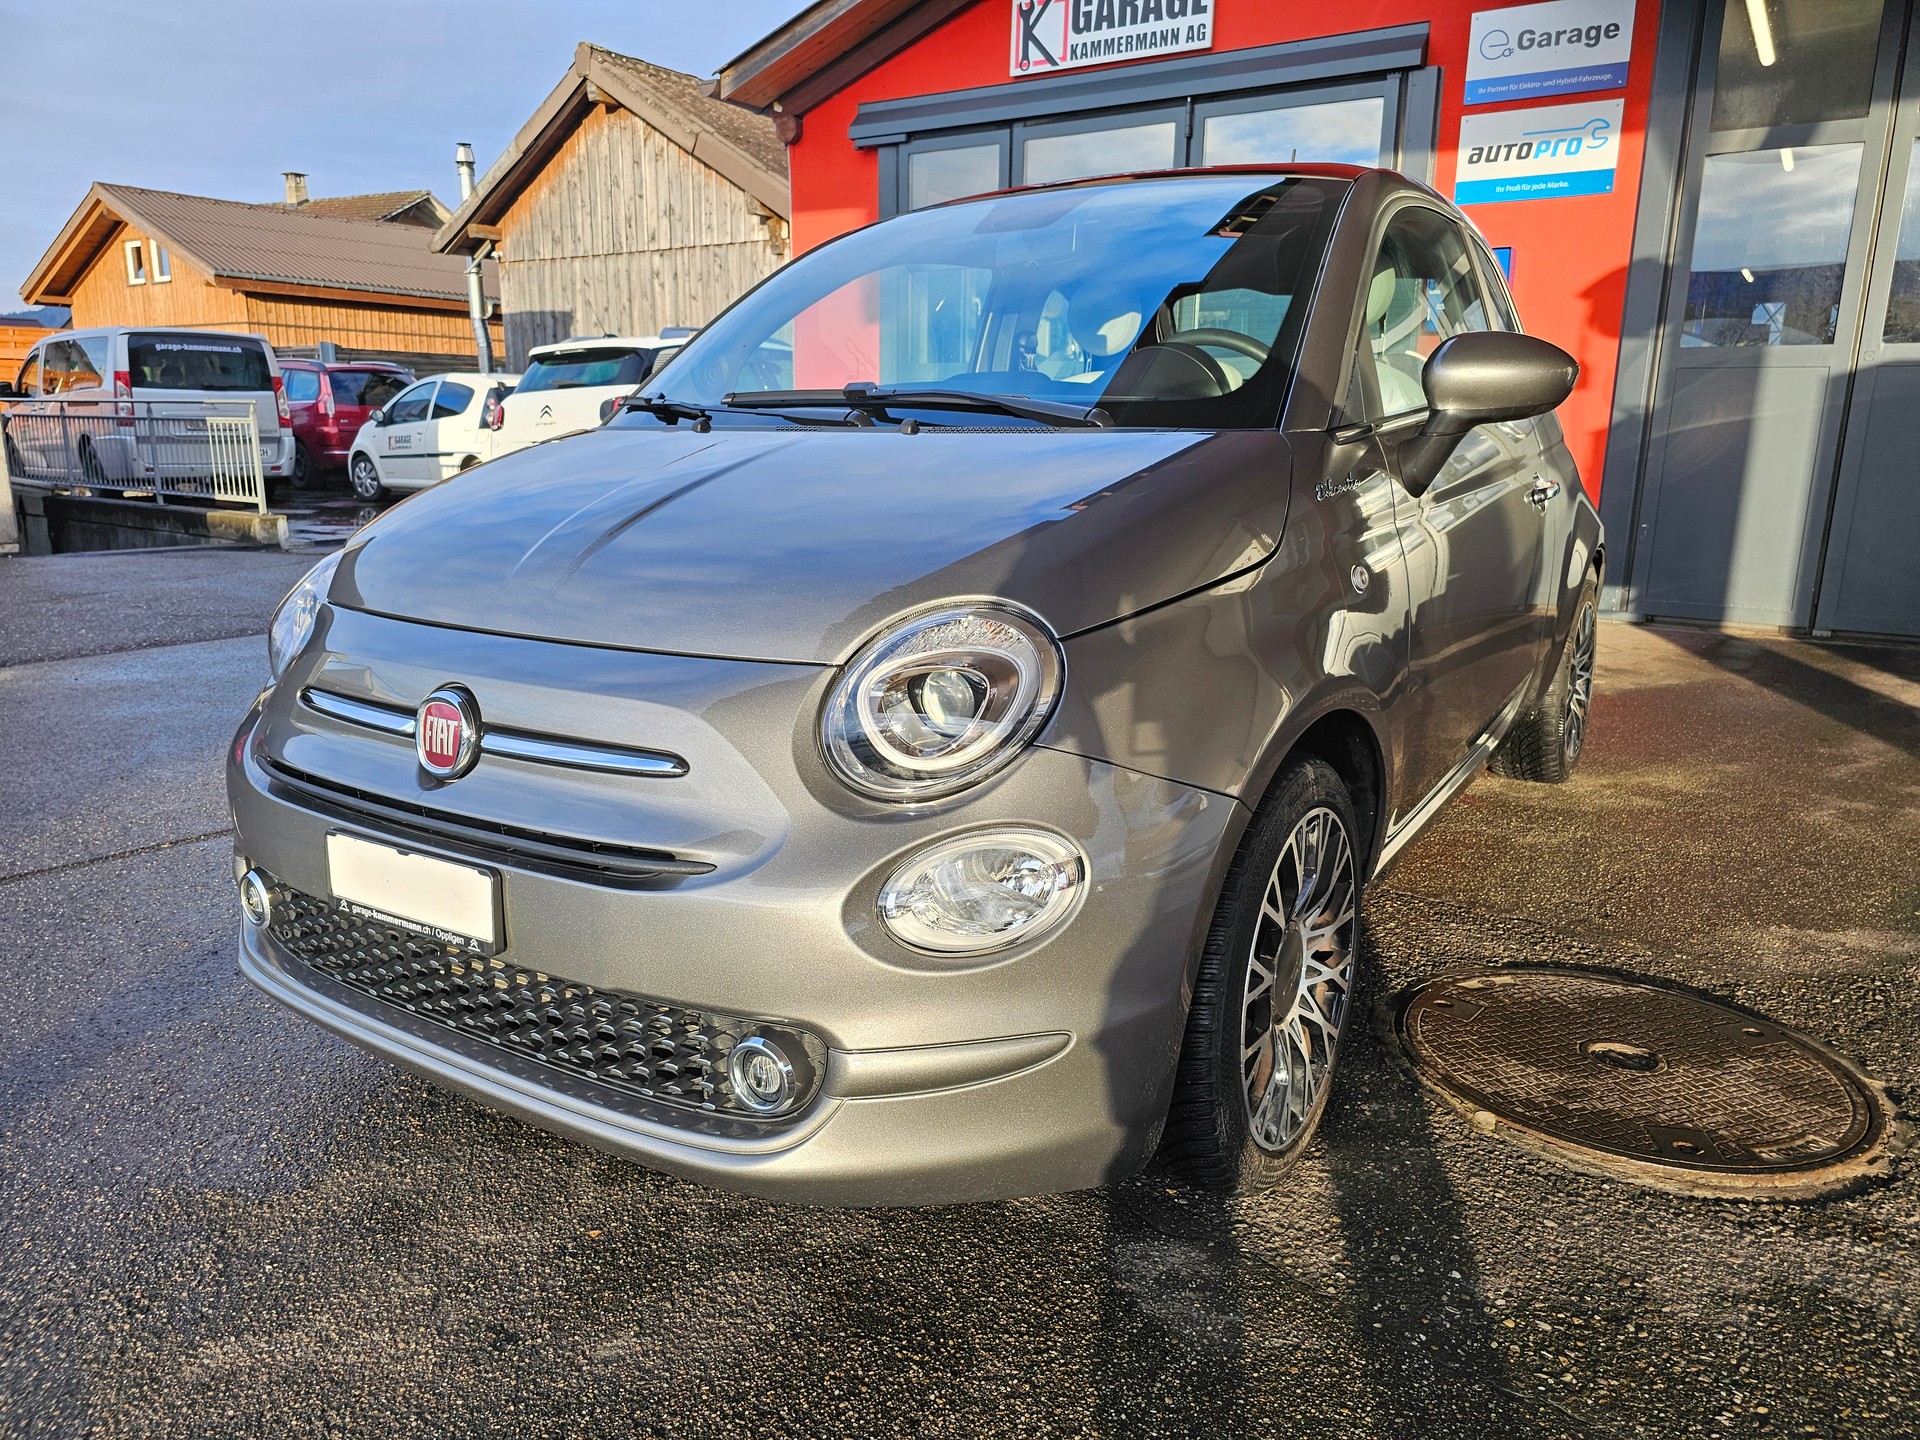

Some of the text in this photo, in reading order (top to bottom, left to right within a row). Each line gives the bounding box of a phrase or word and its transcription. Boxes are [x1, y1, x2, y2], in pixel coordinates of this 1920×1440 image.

[1070, 23, 1206, 61] KAMMERMANN AG
[1517, 22, 1620, 51] Garage
[1487, 86, 1509, 94] Partner
[1509, 83, 1518, 91] für
[1519, 81, 1542, 90] Elektro-
[1542, 79, 1555, 87] und
[1556, 73, 1613, 86] Hybrid-Fahrzeuge.
[1495, 181, 1569, 193] Ihr Profi für jede Marke.
[155, 343, 242, 353] garage-kammermann.ch
[425, 715, 459, 756] FIAT
[352, 904, 431, 936] garage-kammermann.ch
[435, 928, 465, 946] Oppligen
